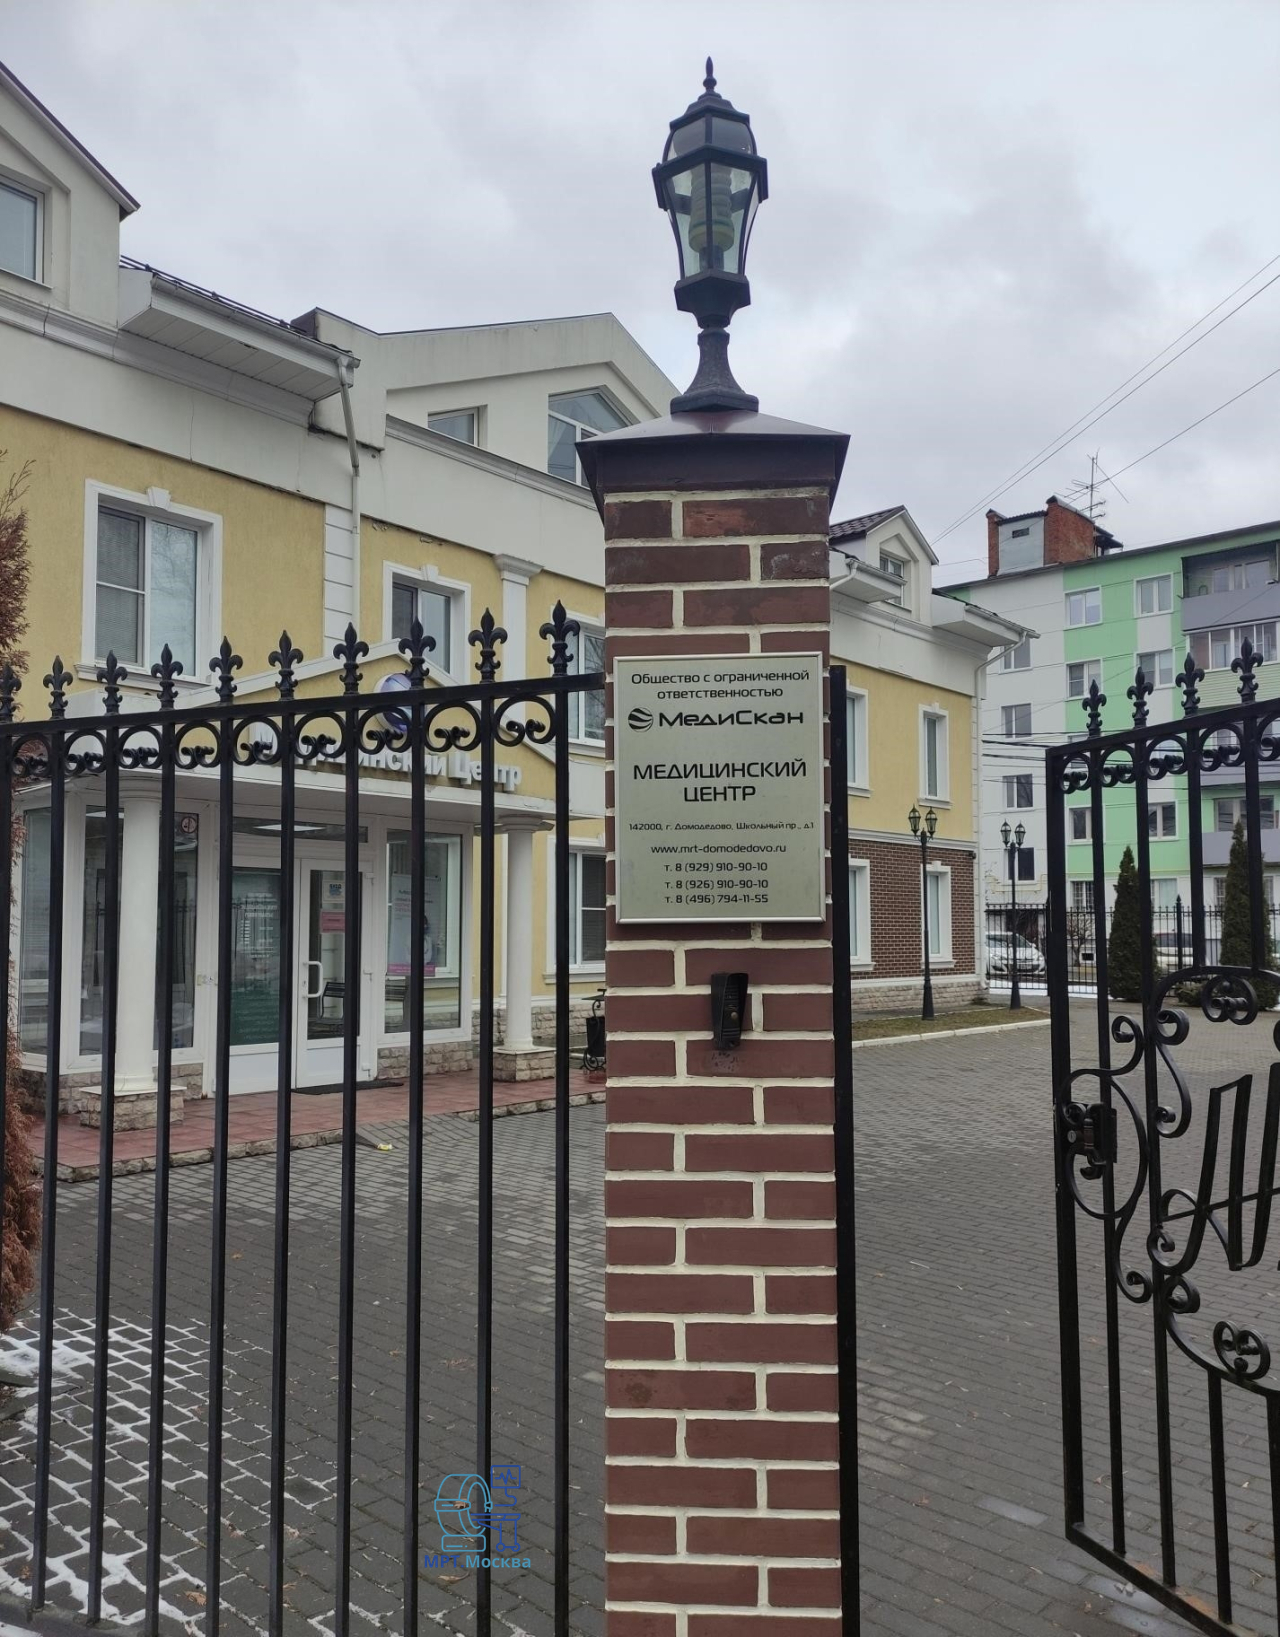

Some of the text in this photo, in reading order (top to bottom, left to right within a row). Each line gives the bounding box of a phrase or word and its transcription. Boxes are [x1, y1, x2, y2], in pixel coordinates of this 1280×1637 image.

[631, 669, 810, 685] Общество с ограниченной
[657, 687, 784, 700] ответственностью
[659, 710, 804, 728] МедиСкан
[633, 758, 807, 780] МЕДИЦИНСКИЙ
[684, 786, 757, 802] ЦЕНТР
[629, 823, 664, 832] 142000,
[674, 823, 733, 831] Домодедово,
[735, 821, 785, 830] Школьный
[650, 844, 787, 854] www.mrt-domodedovo.ru
[664, 862, 769, 873] т. 8 (929) 910-90-10
[664, 879, 769, 890] т. 8 (926) 910-90-10
[664, 894, 769, 905] т. 8 (496) 794-11-55
